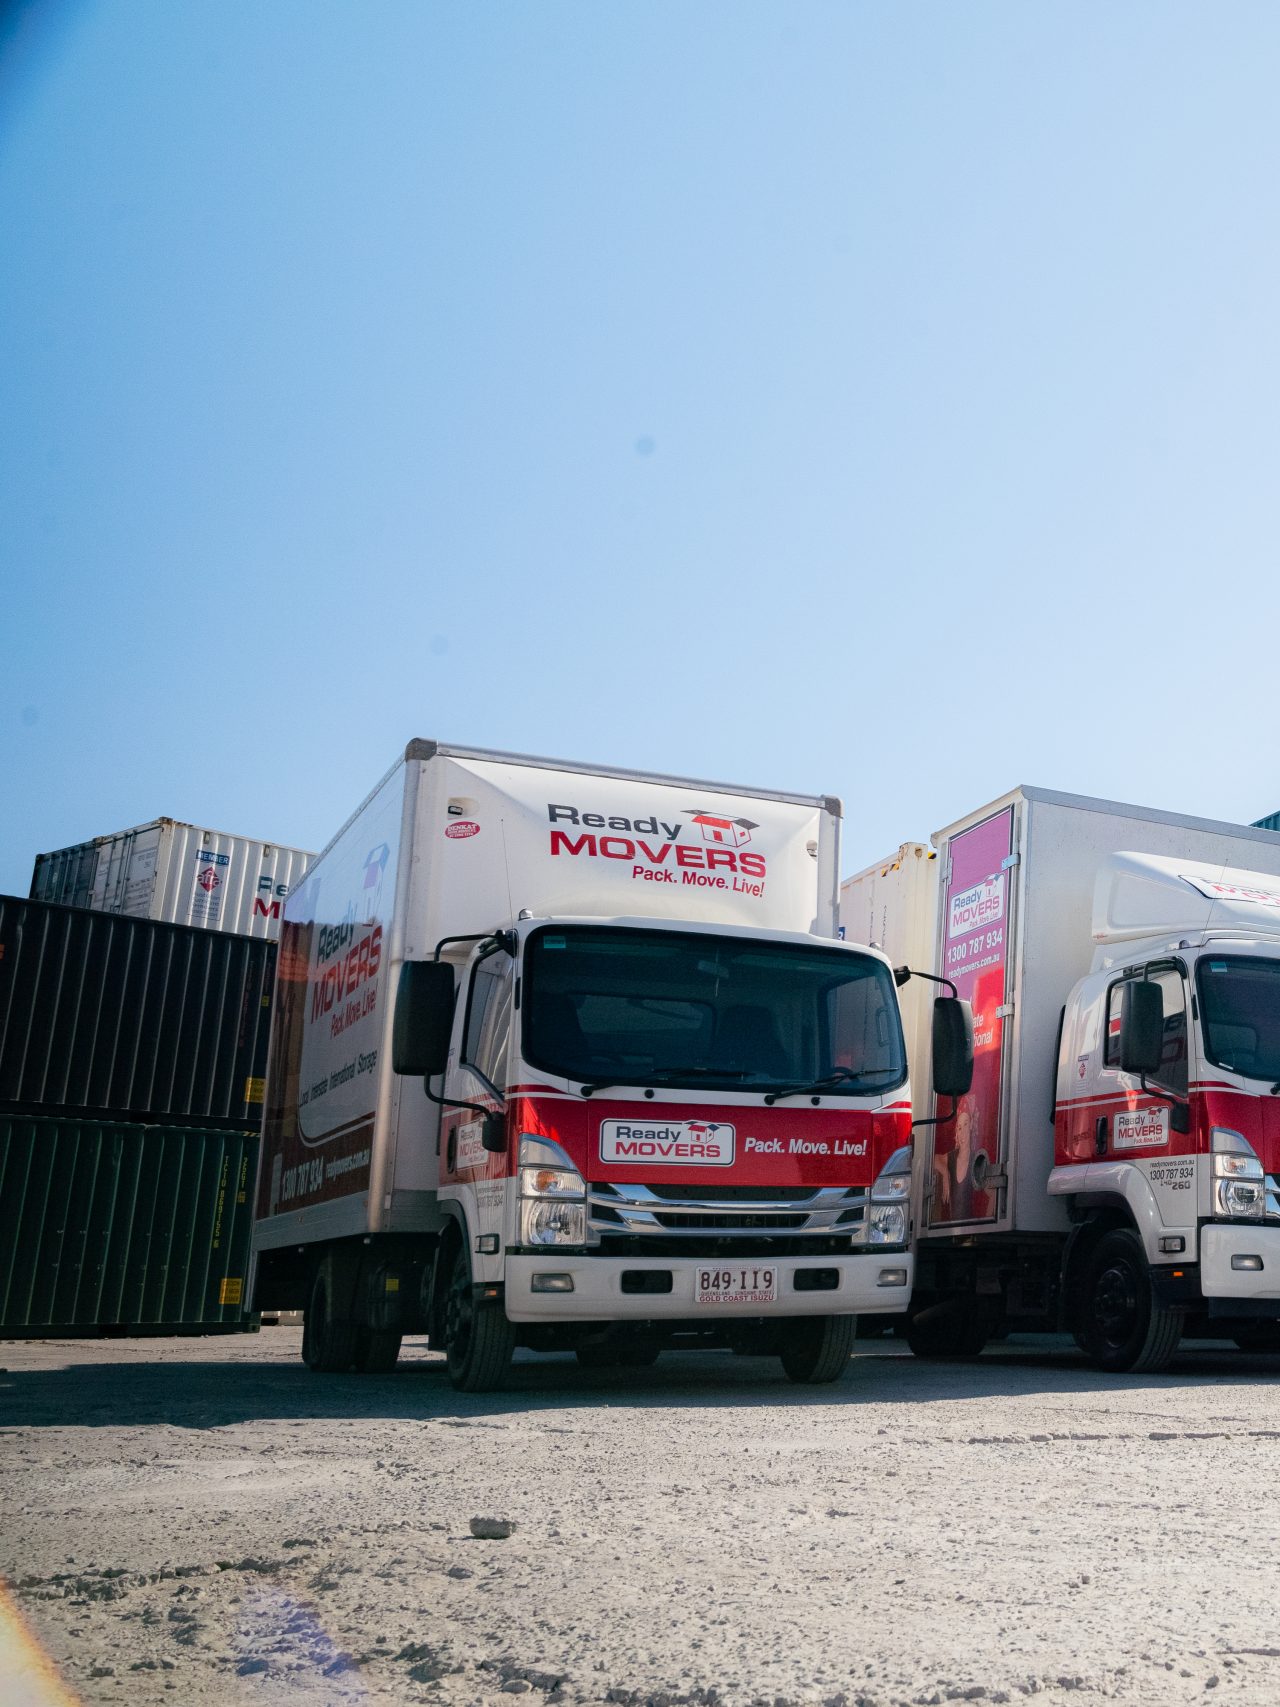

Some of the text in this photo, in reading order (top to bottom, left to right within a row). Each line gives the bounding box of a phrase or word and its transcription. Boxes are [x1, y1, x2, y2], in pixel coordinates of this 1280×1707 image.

[548, 803, 682, 841] Ready
[197, 852, 229, 865] MEMBER
[550, 831, 767, 878] MOVERS
[258, 875, 290, 897] Re
[632, 866, 765, 898] Pack. Move. Live!
[253, 898, 281, 919] M
[953, 889, 983, 912] Ready
[952, 895, 1000, 928] MOVERS
[317, 913, 356, 967] Ready
[947, 927, 1003, 965] 1300 787 934
[311, 925, 382, 1024] MOVERS
[949, 952, 1000, 980] readymovers.com.au
[973, 1012, 984, 1028] ate
[973, 1029, 993, 1048] ional
[357, 1050, 377, 1075] Storage
[1119, 1115, 1145, 1126] Ready
[616, 1125, 681, 1142] Ready
[1118, 1125, 1162, 1139] MOVERS
[615, 1141, 720, 1158] MOVERS
[745, 1138, 867, 1156] Pack. Move. Live!
[1150, 1160, 1195, 1168] readymovers.com.au
[1150, 1167, 1194, 1180] 1300 787 934
[1172, 1181, 1191, 1190] 260
